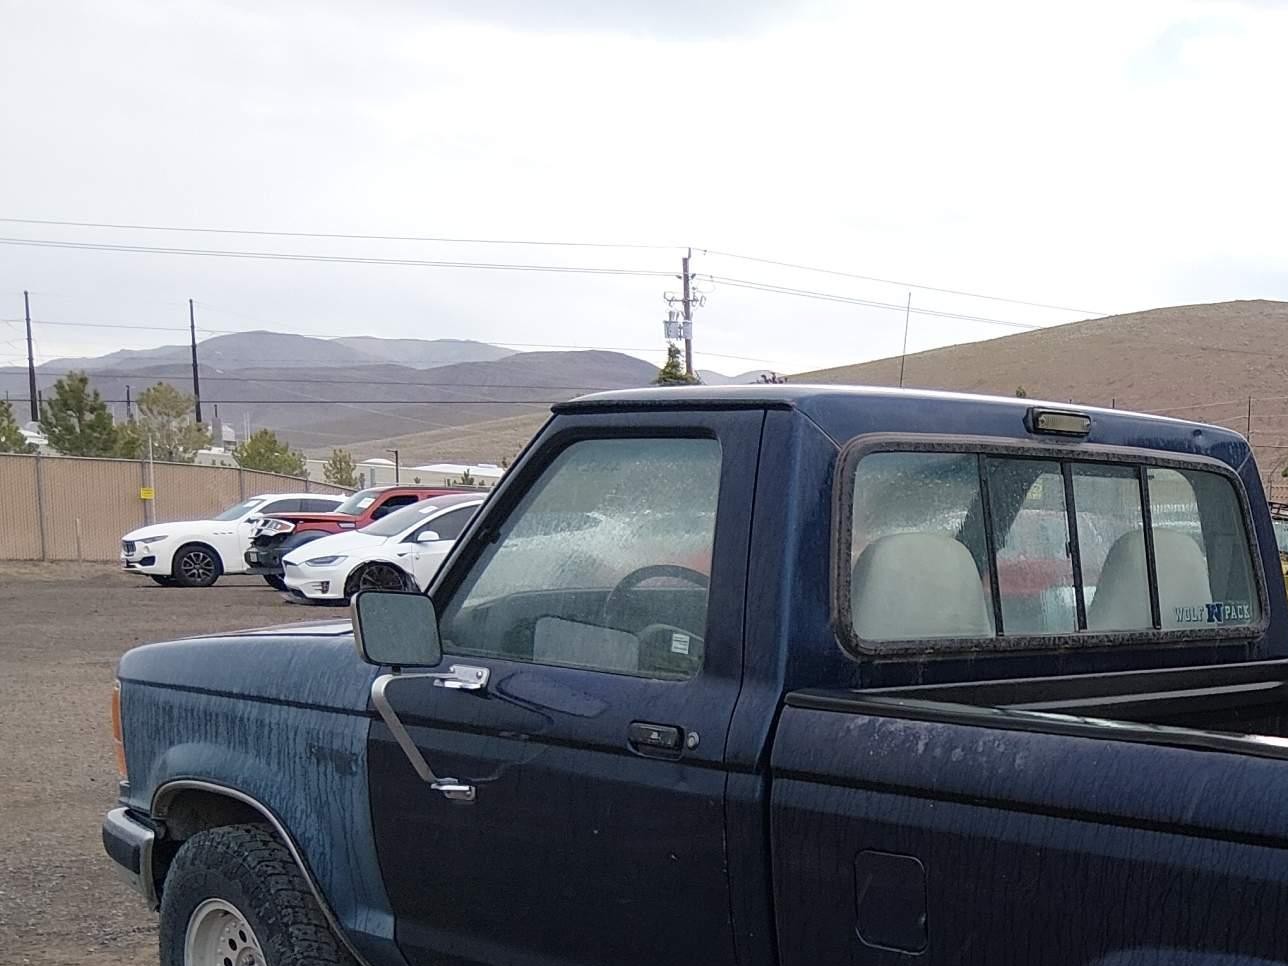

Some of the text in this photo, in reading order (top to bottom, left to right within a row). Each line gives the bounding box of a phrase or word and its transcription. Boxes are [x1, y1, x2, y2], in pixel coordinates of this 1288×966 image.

[1175, 602, 1250, 624] WOLF N PACK
